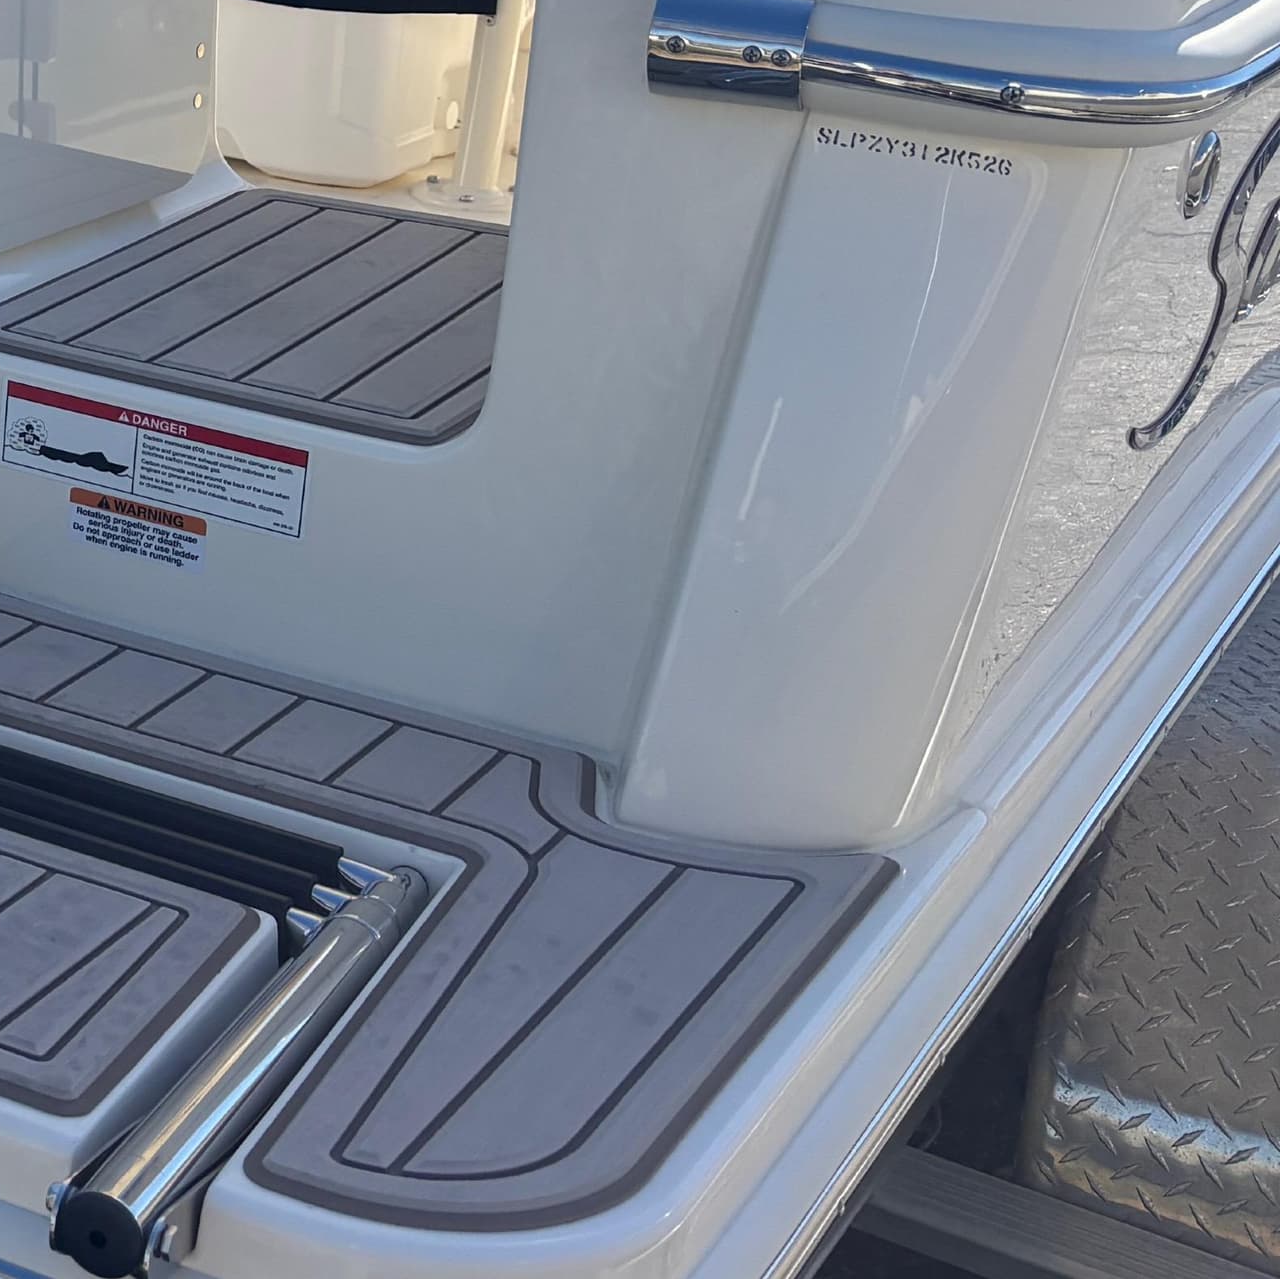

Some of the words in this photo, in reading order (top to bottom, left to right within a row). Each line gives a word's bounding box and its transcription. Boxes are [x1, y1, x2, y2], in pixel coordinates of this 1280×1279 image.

[132, 414, 188, 437] DANGER
[76, 506, 110, 522] Rotating
[112, 516, 150, 532] propeller
[152, 527, 169, 538] may
[171, 532, 197, 544] cause
[113, 500, 184, 528] WARNING
[73, 521, 84, 531] Do
[86, 525, 99, 535] not
[101, 530, 141, 547] approach
[143, 541, 152, 549] or
[154, 544, 170, 553] use
[171, 547, 198, 561] ladder
[88, 518, 118, 531] serious
[120, 526, 143, 539] injury
[157, 535, 184, 549] death.
[85, 534, 107, 545] when
[109, 541, 137, 555] engine
[149, 550, 184, 567] running.
